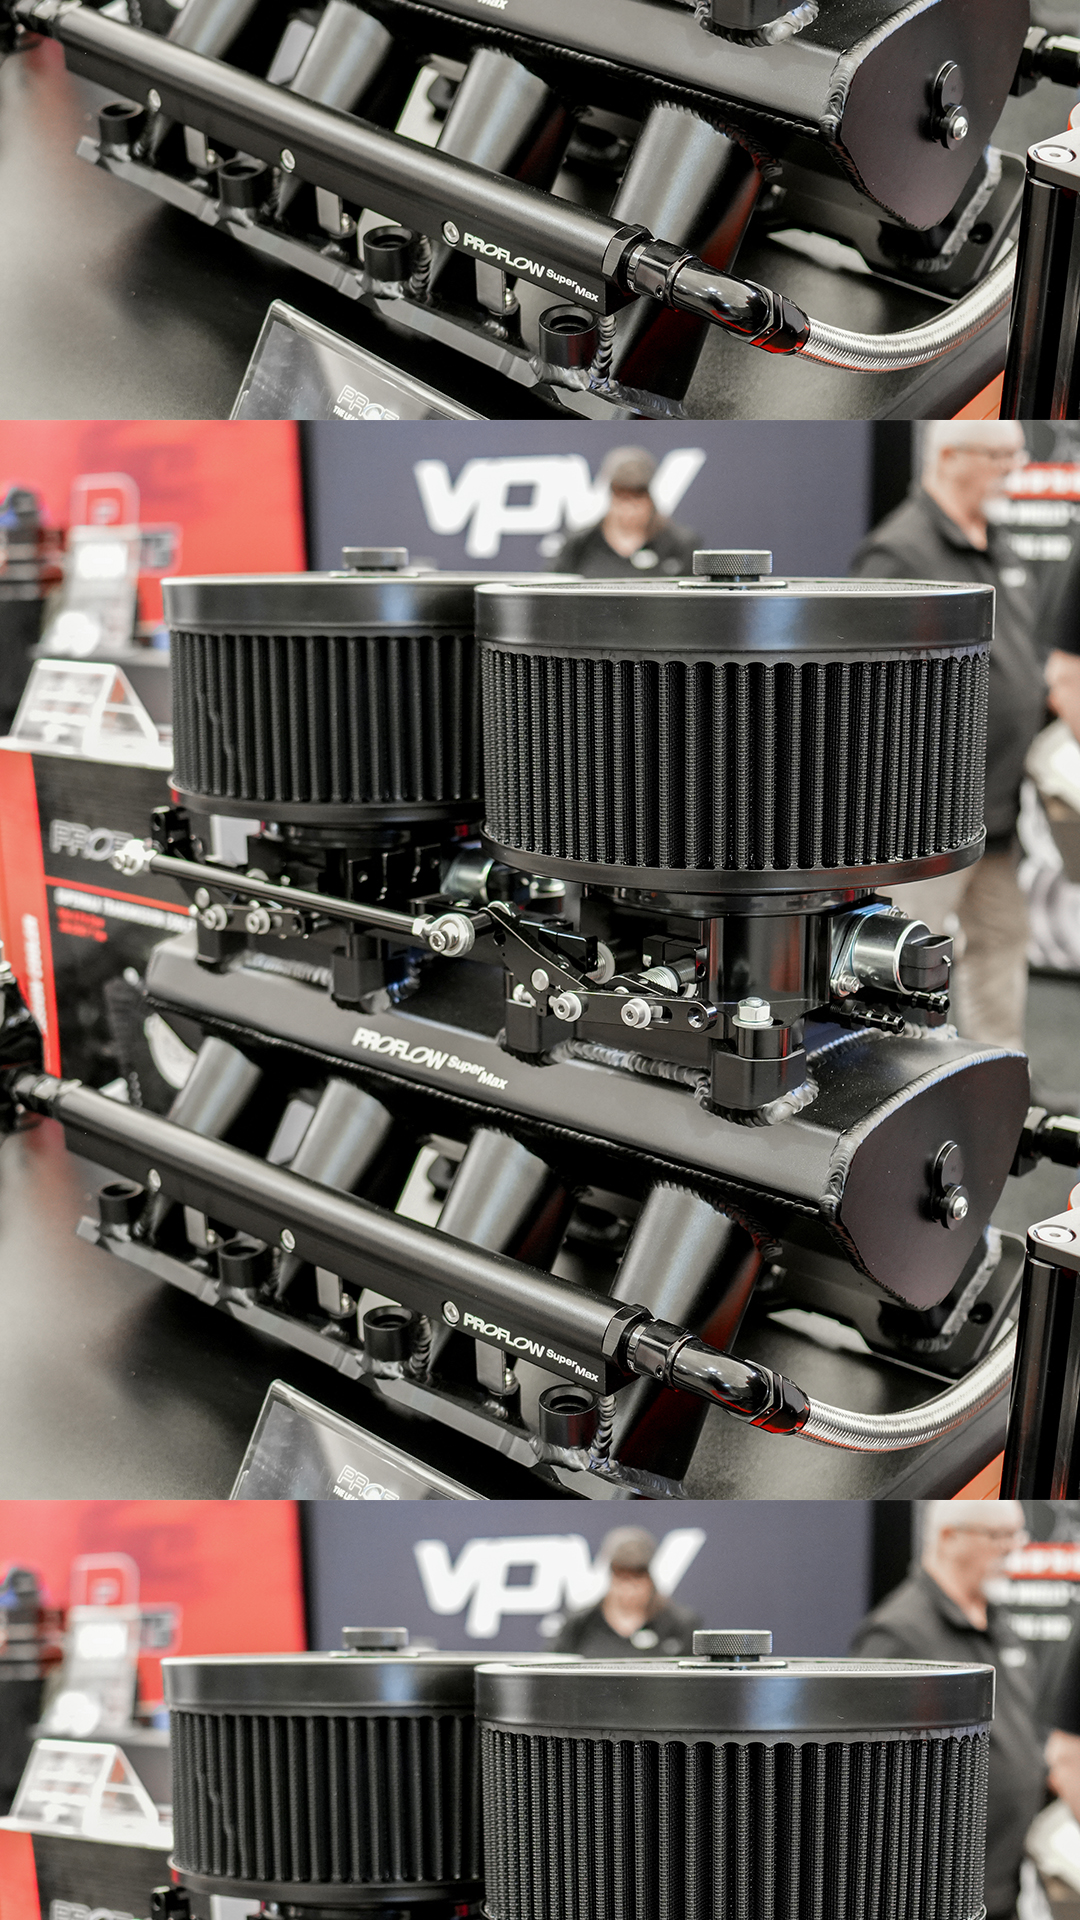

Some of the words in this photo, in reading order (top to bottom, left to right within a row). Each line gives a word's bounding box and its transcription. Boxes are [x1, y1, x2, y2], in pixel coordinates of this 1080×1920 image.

[463, 232, 545, 277] PROFLOW
[546, 268, 577, 288] Super
[574, 285, 599, 302] Max
[351, 1026, 449, 1071] PROFLOW
[447, 1054, 485, 1076] Super
[477, 1070, 508, 1090] Max
[463, 1312, 545, 1357] PROFLOW
[546, 1348, 577, 1368] Super
[574, 1365, 599, 1382] Max
